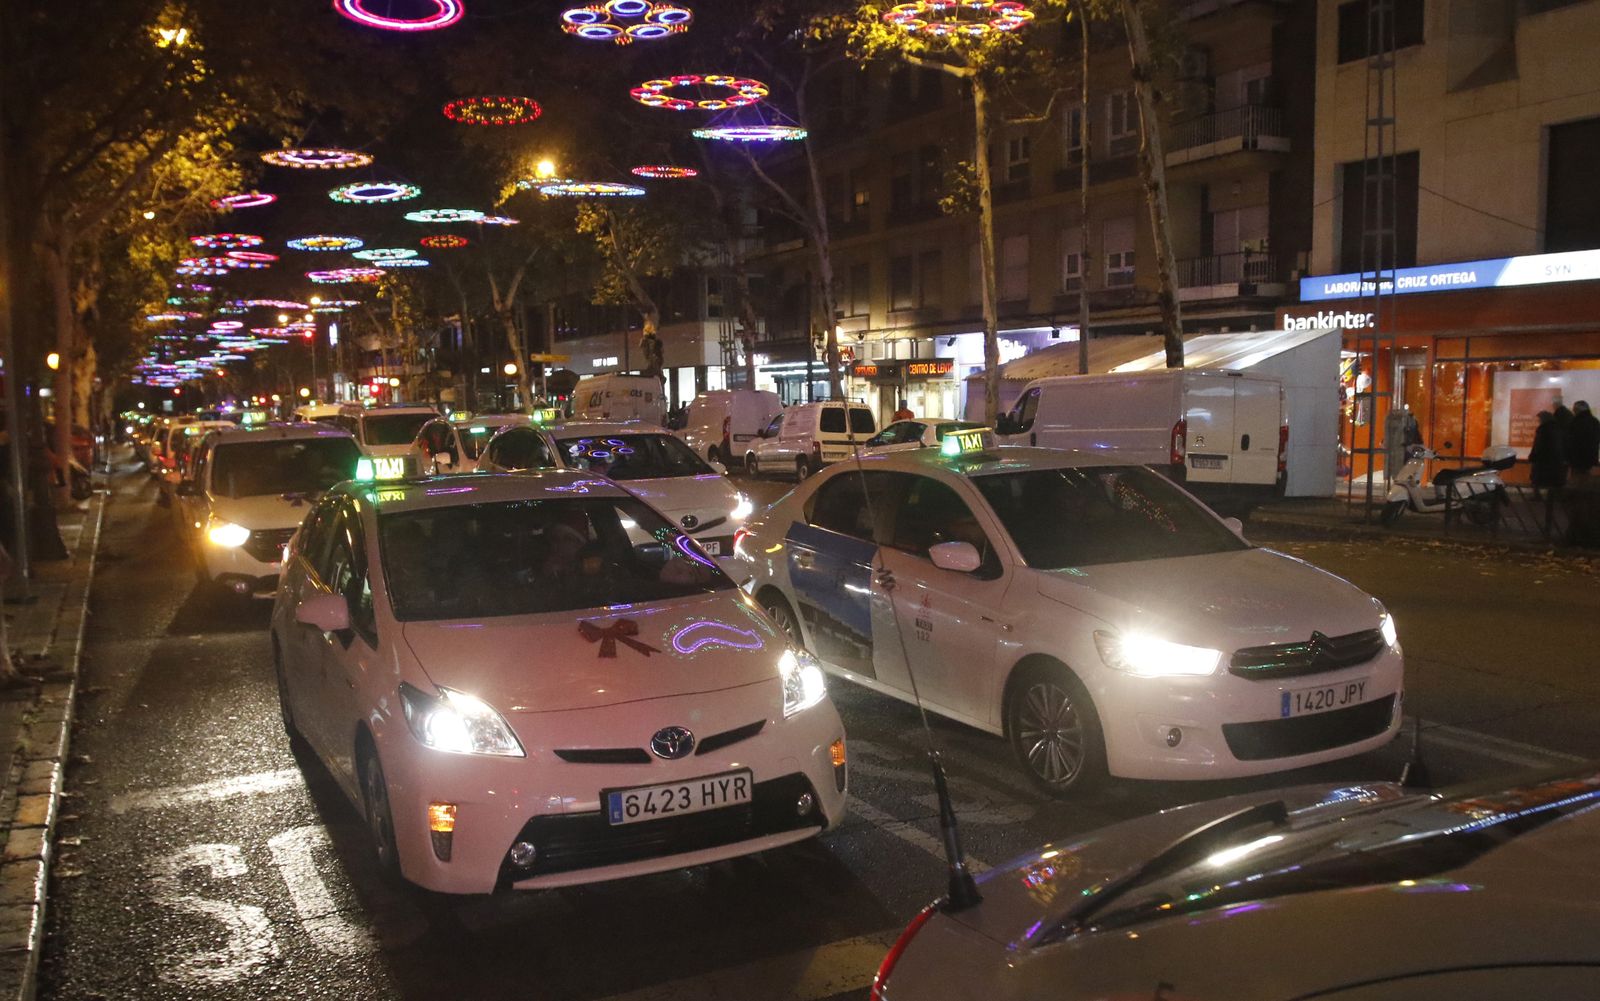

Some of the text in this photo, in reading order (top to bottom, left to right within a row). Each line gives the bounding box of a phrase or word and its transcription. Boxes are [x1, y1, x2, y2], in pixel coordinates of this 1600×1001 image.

[1397, 275, 1428, 288] CRUZ
[1430, 272, 1477, 286] ORTEGA
[909, 363, 929, 375] CENTRO
[929, 363, 937, 374] DE
[958, 432, 983, 450] TAXI
[373, 457, 404, 479] TAXI
[1296, 681, 1365, 713] 1420 JPY
[625, 777, 747, 818] 6423 HYR
